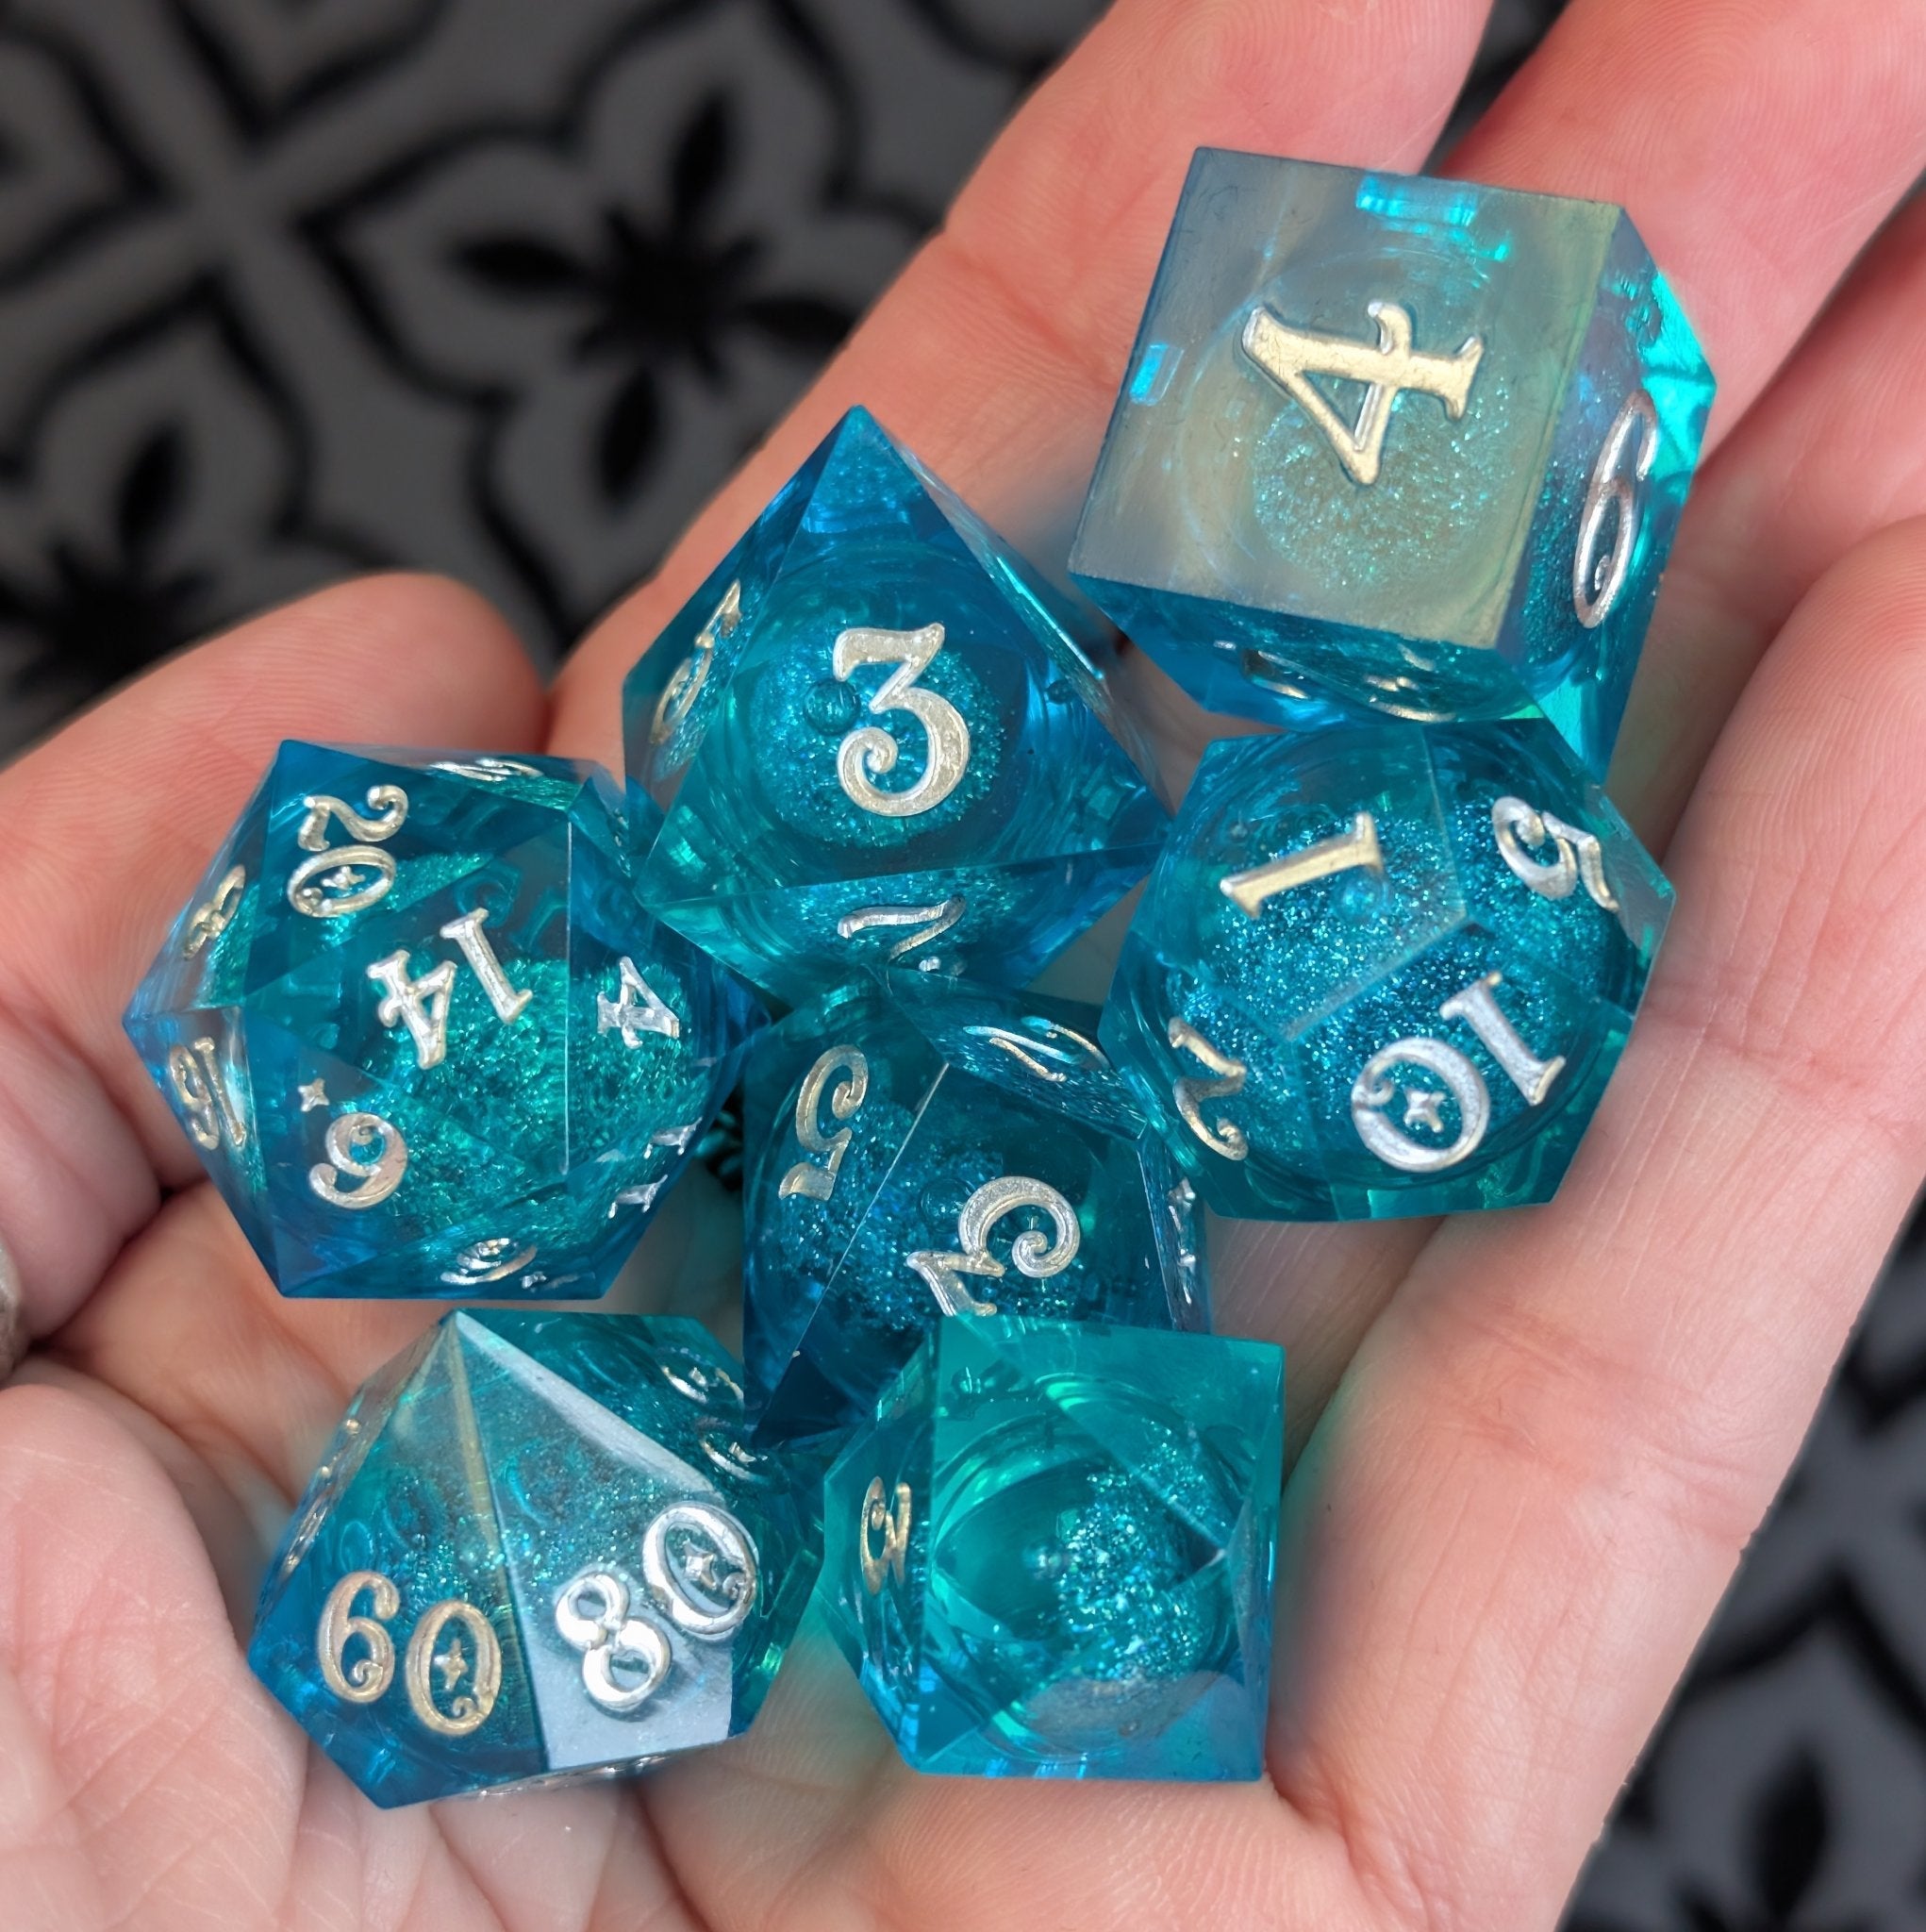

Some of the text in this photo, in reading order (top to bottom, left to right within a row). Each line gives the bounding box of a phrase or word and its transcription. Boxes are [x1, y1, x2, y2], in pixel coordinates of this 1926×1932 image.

[1241, 299, 1485, 485] 4
[1573, 390, 1658, 630] 6
[832, 622, 971, 817] 3
[286, 785, 408, 918] 20
[1220, 810, 1385, 921] 1
[1490, 794, 1620, 912] 5
[367, 906, 534, 1070] 14
[596, 955, 681, 1050] 4
[777, 1043, 870, 1202] 5
[1167, 1016, 1250, 1161] 2
[1349, 970, 1567, 1173] 10
[905, 1174, 1082, 1318] 3
[555, 1501, 760, 1715] 80
[859, 1475, 912, 1595] 3
[317, 1570, 503, 1738] 60
